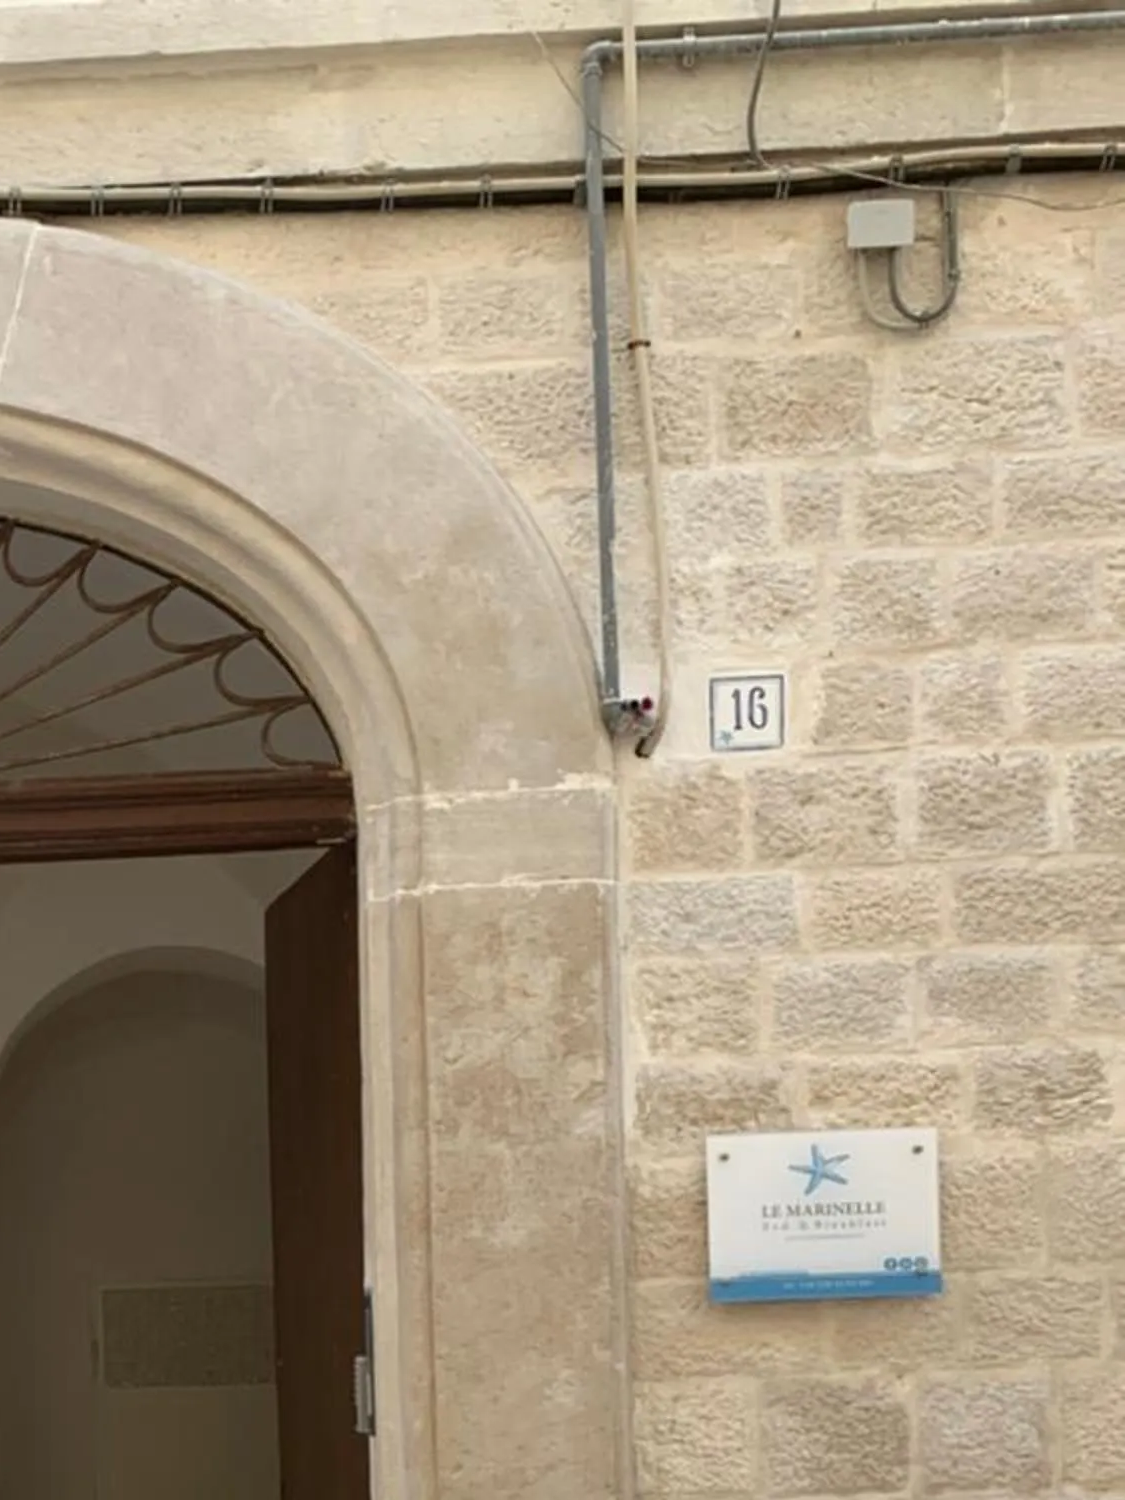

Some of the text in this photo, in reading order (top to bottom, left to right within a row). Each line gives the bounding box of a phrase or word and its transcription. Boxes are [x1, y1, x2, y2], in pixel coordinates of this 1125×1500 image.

[731, 686, 768, 731] 16
[762, 1201, 885, 1219] LE MARINELLE
